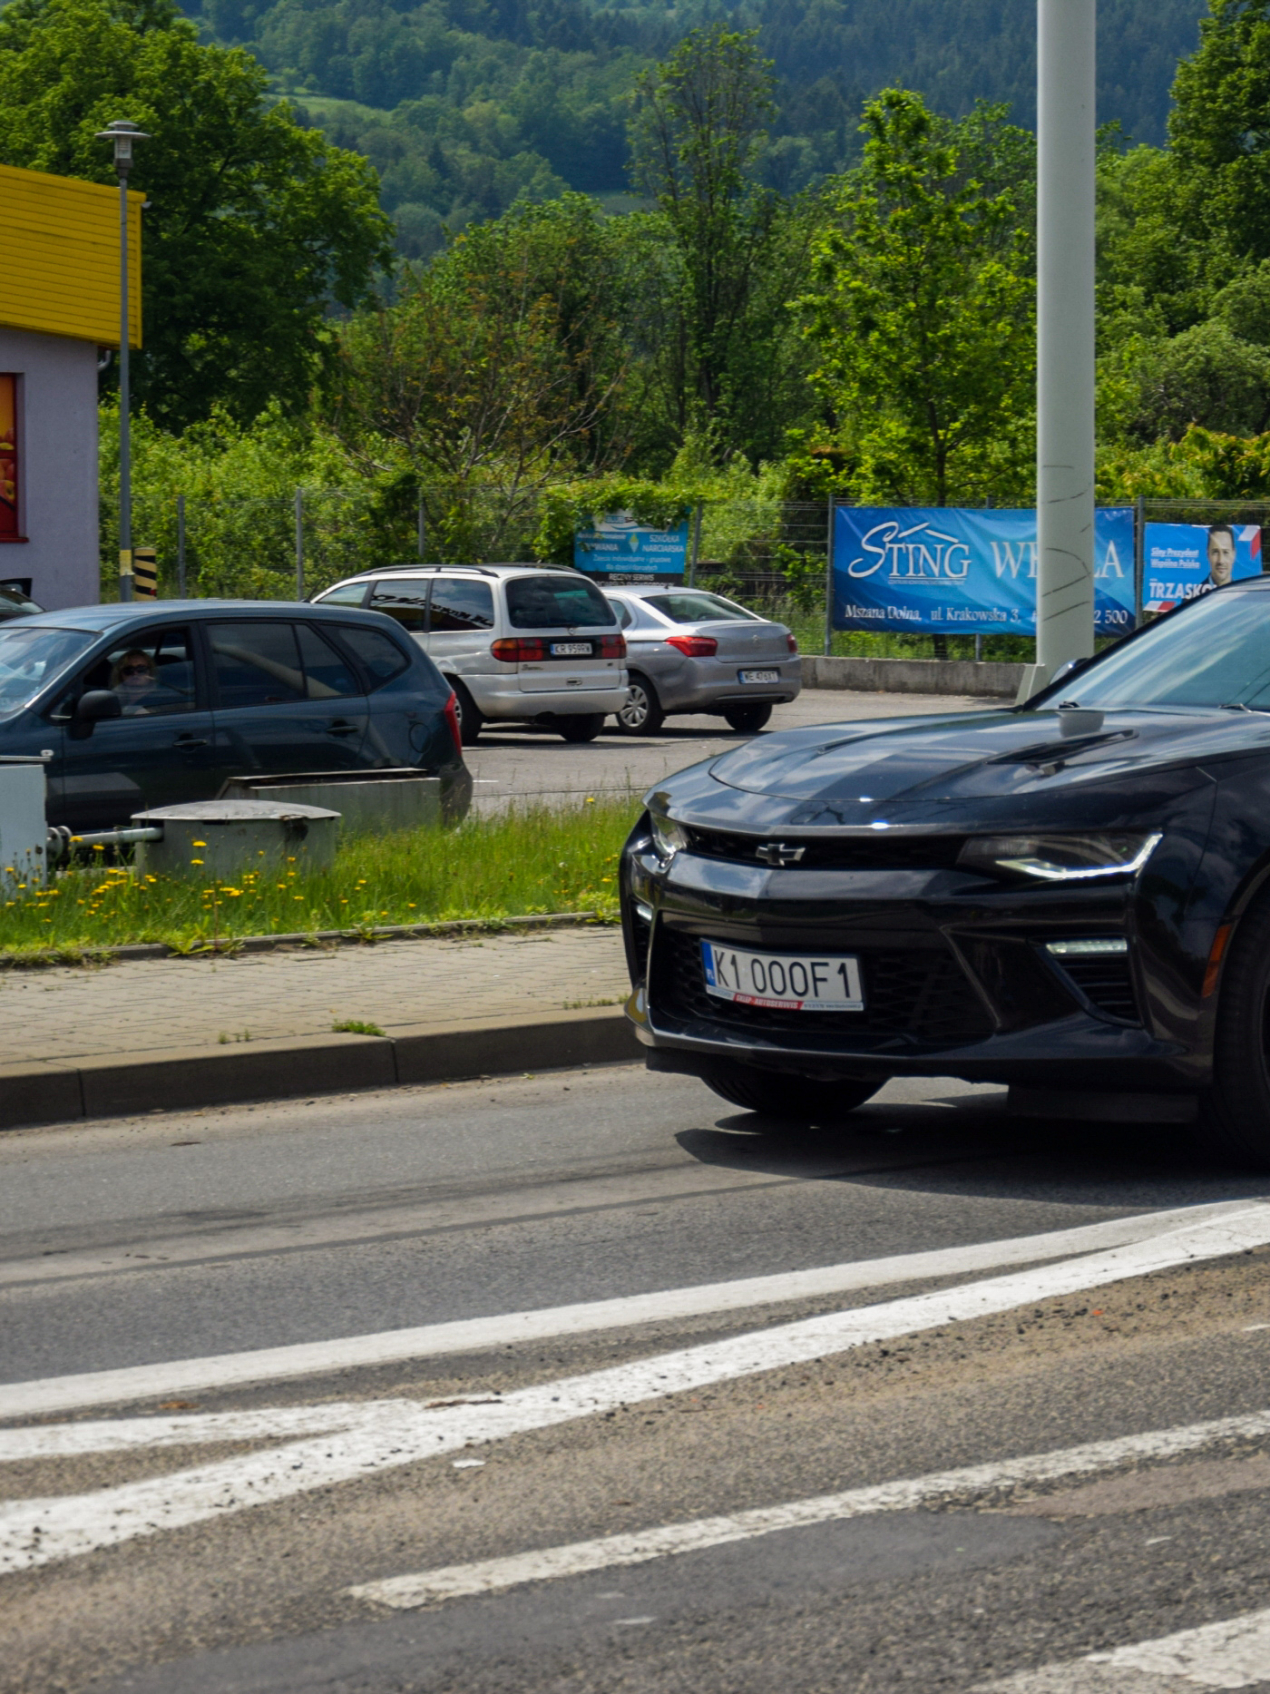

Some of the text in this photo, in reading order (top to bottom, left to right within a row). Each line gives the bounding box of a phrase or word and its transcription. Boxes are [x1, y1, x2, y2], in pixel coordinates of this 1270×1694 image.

[845, 604, 886, 619] Mszana
[946, 607, 1007, 622] Krakowska
[1104, 610, 1128, 625] 500
[714, 949, 851, 998] K1 000F1
[754, 998, 799, 1009] AUTOSERWIS
